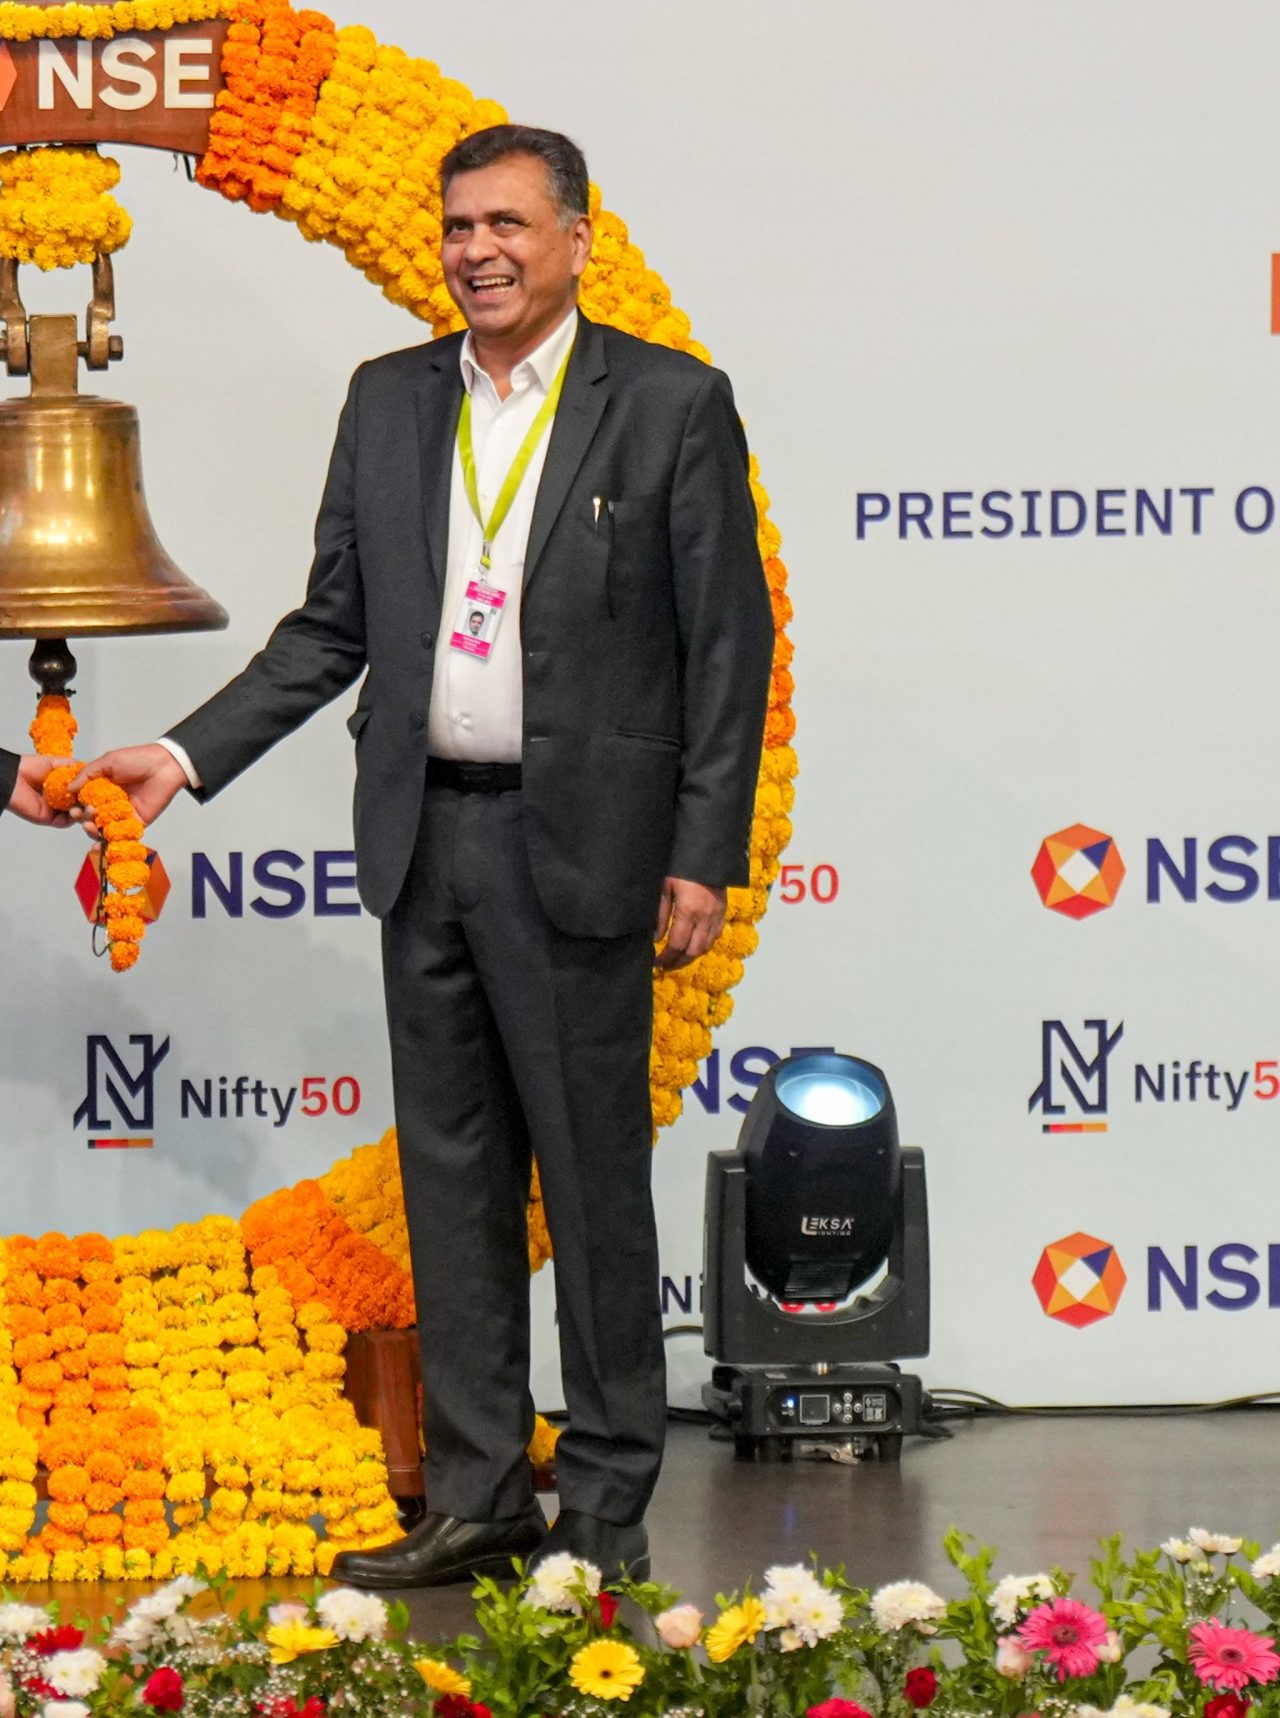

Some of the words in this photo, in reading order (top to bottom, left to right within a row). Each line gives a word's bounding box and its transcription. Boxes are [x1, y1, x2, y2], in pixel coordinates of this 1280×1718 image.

[38, 38, 214, 110] NSE
[856, 487, 1215, 540] PRESIDENT
[192, 849, 362, 919] NSE
[1146, 834, 1280, 904] NS
[180, 1076, 361, 1128] Nifty50
[1147, 1242, 1280, 1312] NS
